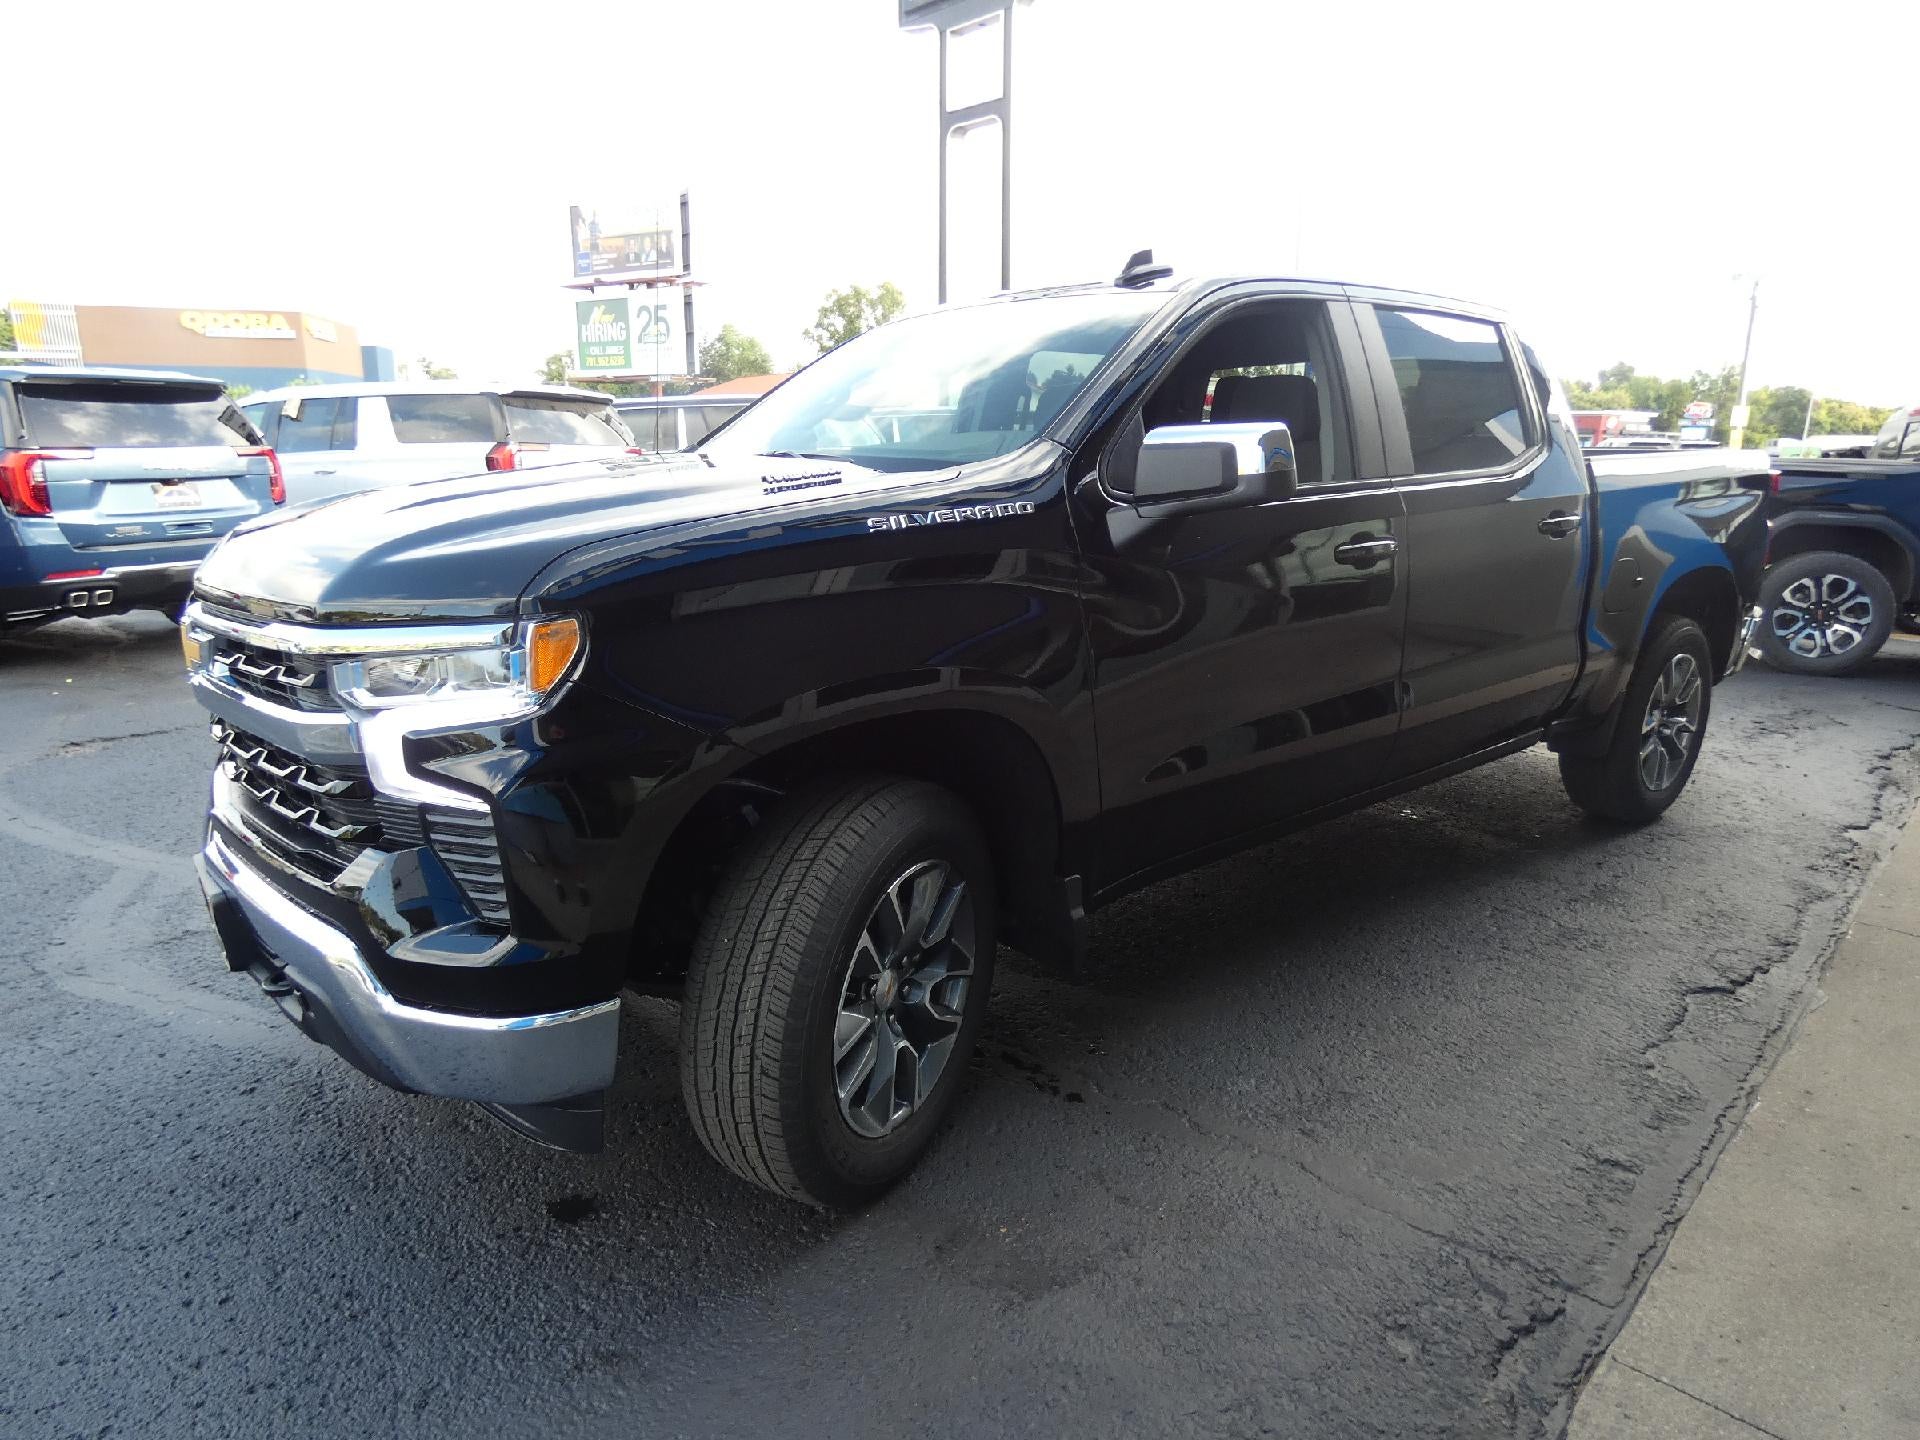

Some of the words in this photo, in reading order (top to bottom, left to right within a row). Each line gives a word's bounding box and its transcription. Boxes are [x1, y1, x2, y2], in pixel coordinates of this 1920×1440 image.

[582, 320, 627, 342] HIRING
[637, 304, 670, 344] 25
[867, 501, 1036, 532] SILVERADO
